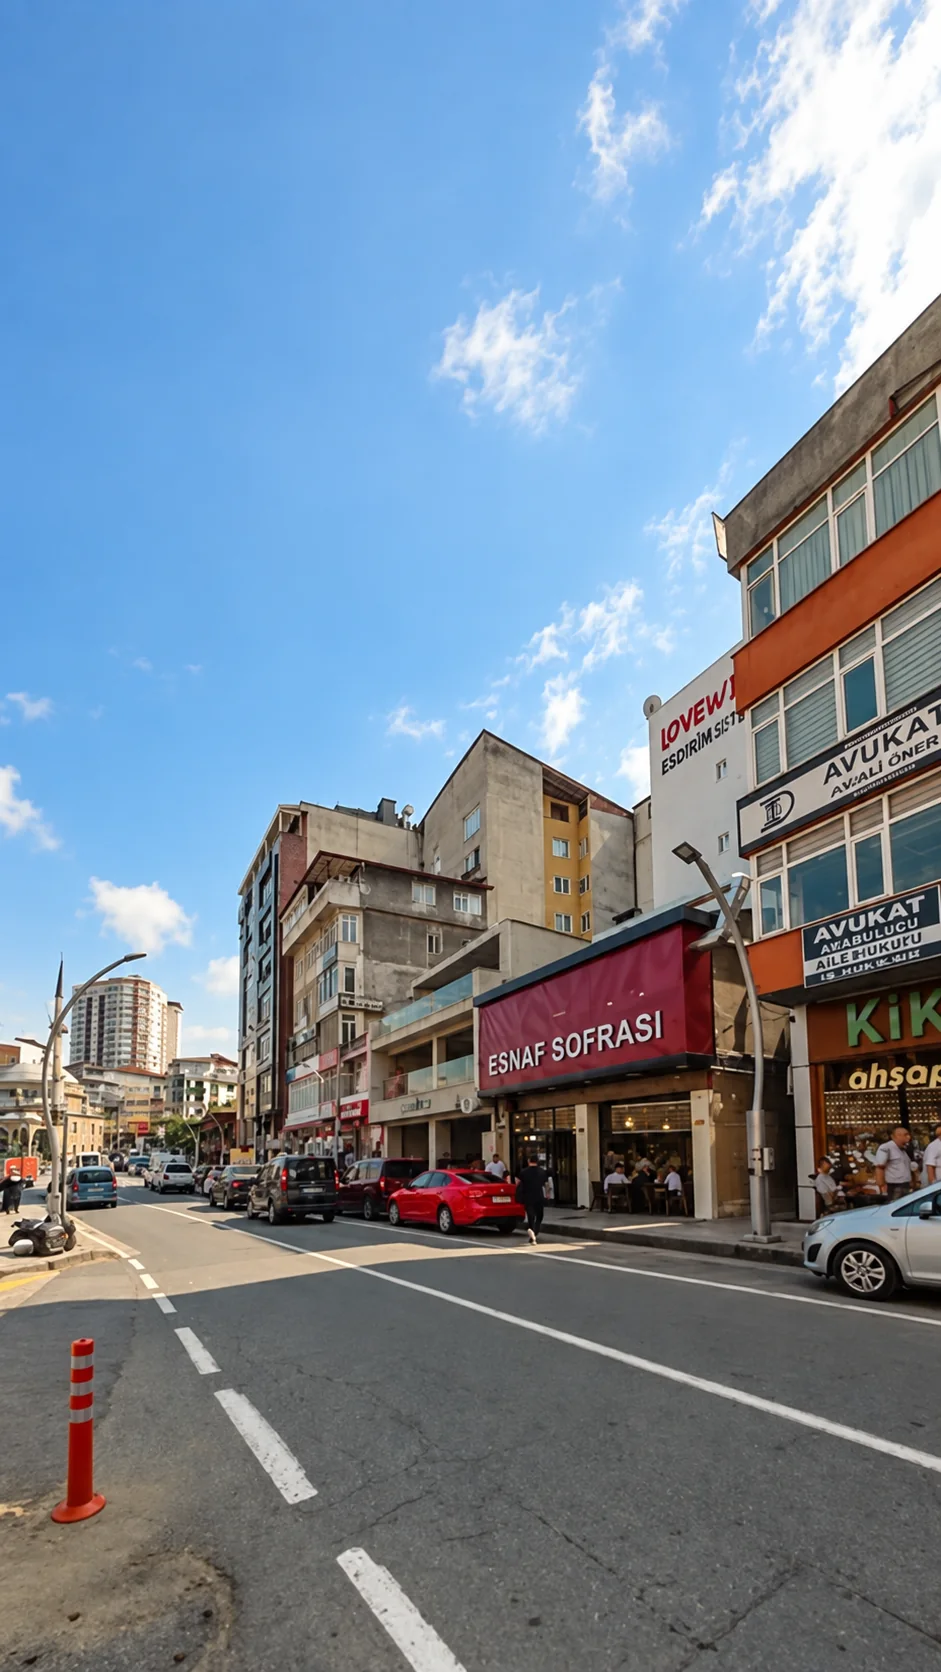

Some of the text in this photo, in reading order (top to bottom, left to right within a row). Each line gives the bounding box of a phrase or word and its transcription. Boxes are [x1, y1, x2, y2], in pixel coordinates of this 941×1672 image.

[888, 735, 939, 767] ÖNER
[813, 894, 925, 944] AVUKAT
[489, 1010, 662, 1076] ESNAF SOFRASI
